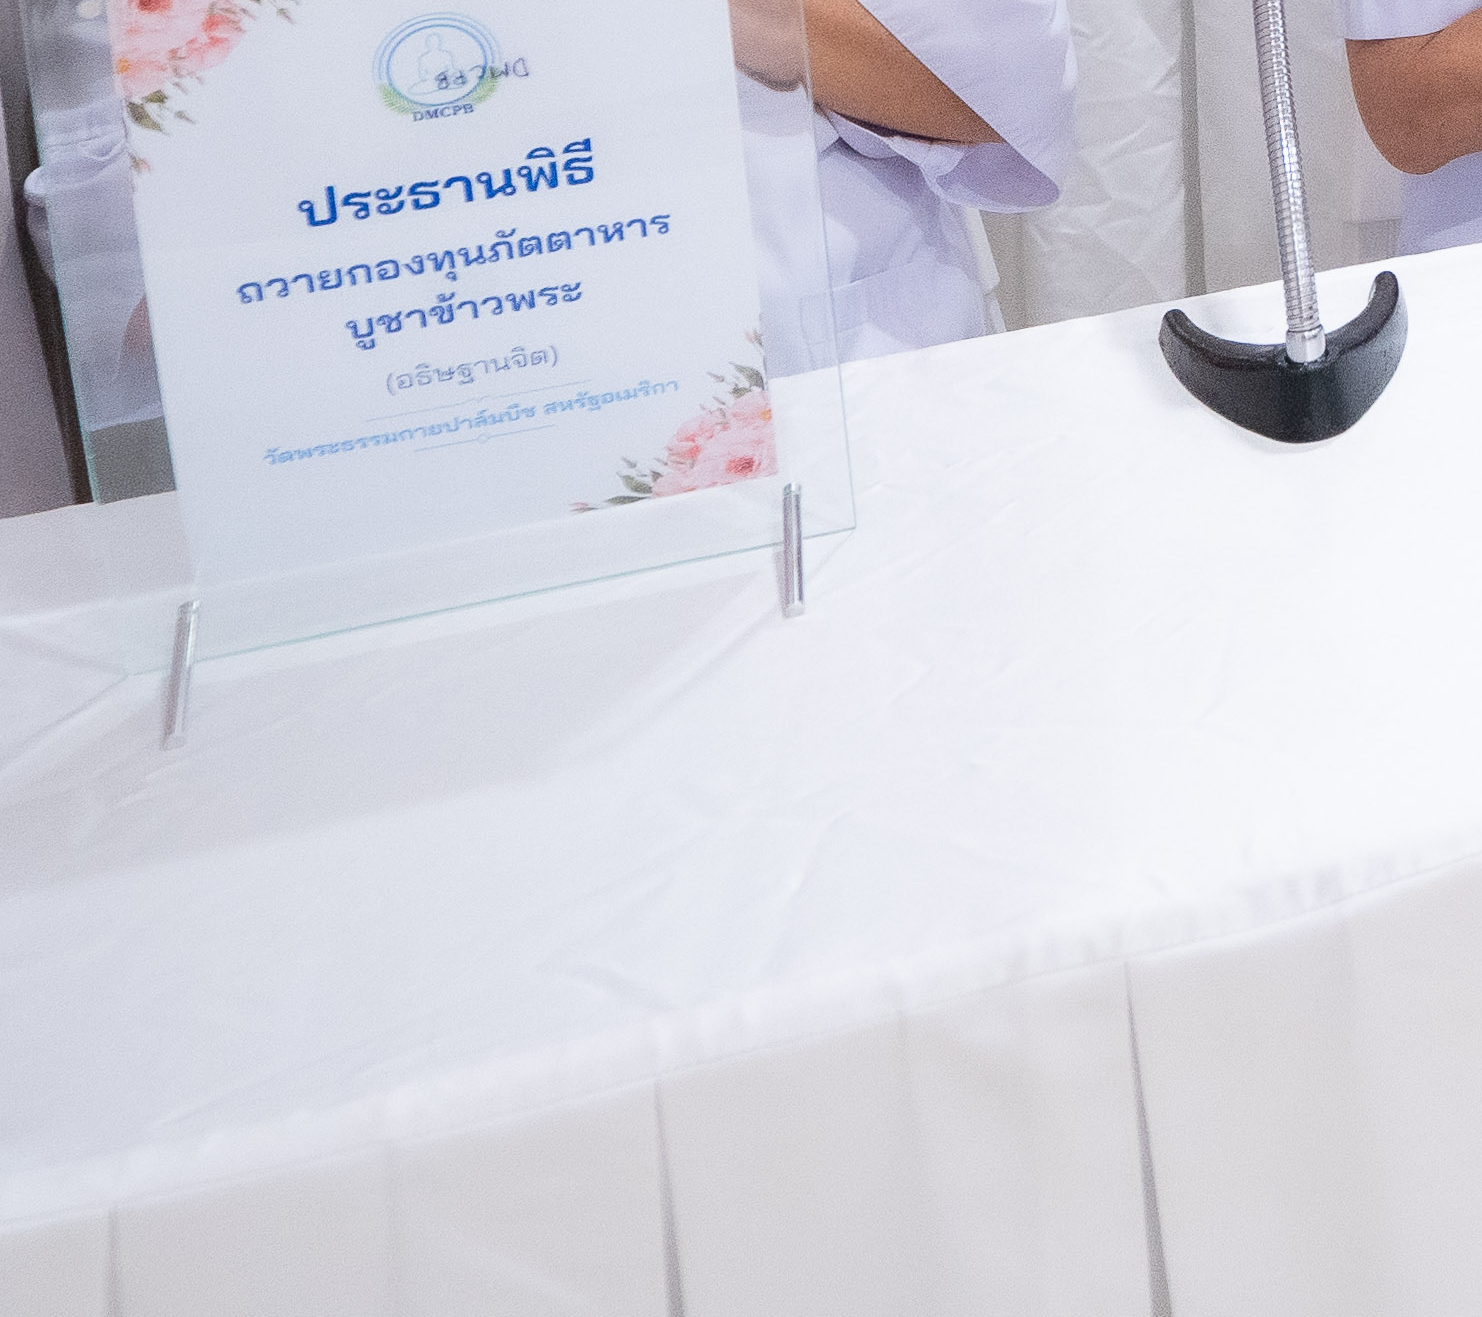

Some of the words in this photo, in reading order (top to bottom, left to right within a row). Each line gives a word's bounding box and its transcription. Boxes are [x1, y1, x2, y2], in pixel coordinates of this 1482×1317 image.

[411, 102, 476, 122] DMCPB
[297, 137, 598, 230] ประธานพิธี
[235, 209, 673, 309] ถวายกองทุนภัตตาหาร
[345, 281, 584, 351] บูชาข้าวพระ
[384, 343, 560, 398] (อธิษฐานจิต)
